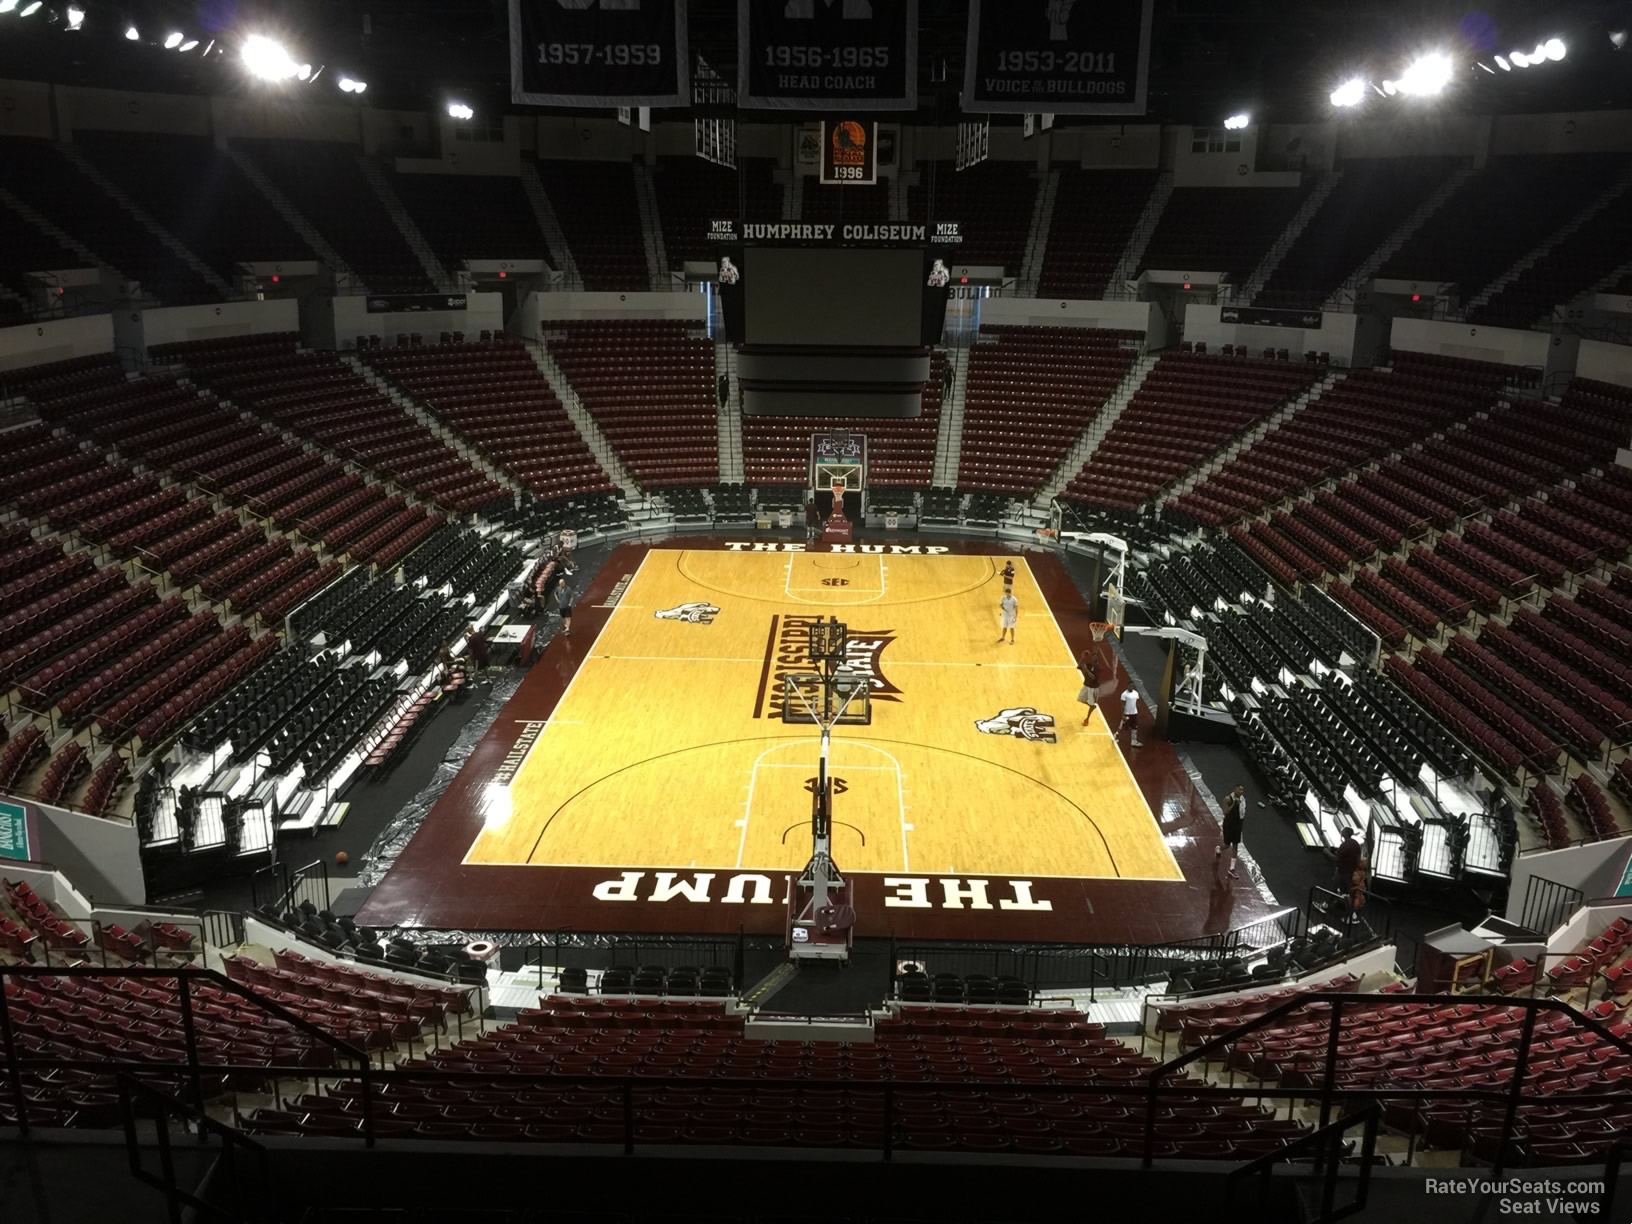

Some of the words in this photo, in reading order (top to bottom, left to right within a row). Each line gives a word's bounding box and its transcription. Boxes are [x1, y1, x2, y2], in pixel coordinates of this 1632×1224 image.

[538, 43, 661, 65] 1957-1959
[766, 45, 889, 68] 1956-1965
[997, 51, 1115, 73] 1953-2011
[778, 75, 821, 89] HEAD
[825, 76, 876, 90] COACH
[985, 78, 1030, 93] VOICE
[1047, 80, 1126, 95] BULLDOGS
[834, 166, 864, 179] 1996
[712, 221, 733, 233] MIZE
[743, 224, 835, 240] HUMPHREY
[843, 225, 926, 241] COLISEUM
[936, 223, 958, 235] MIZE
[707, 233, 738, 241] FOUNDATION
[930, 235, 963, 243] FOUNDATION
[725, 542, 805, 552] THE
[829, 544, 948, 555] HUMP
[822, 578, 850, 586] SEC
[592, 872, 789, 904] UMP
[884, 877, 1054, 911] THE
